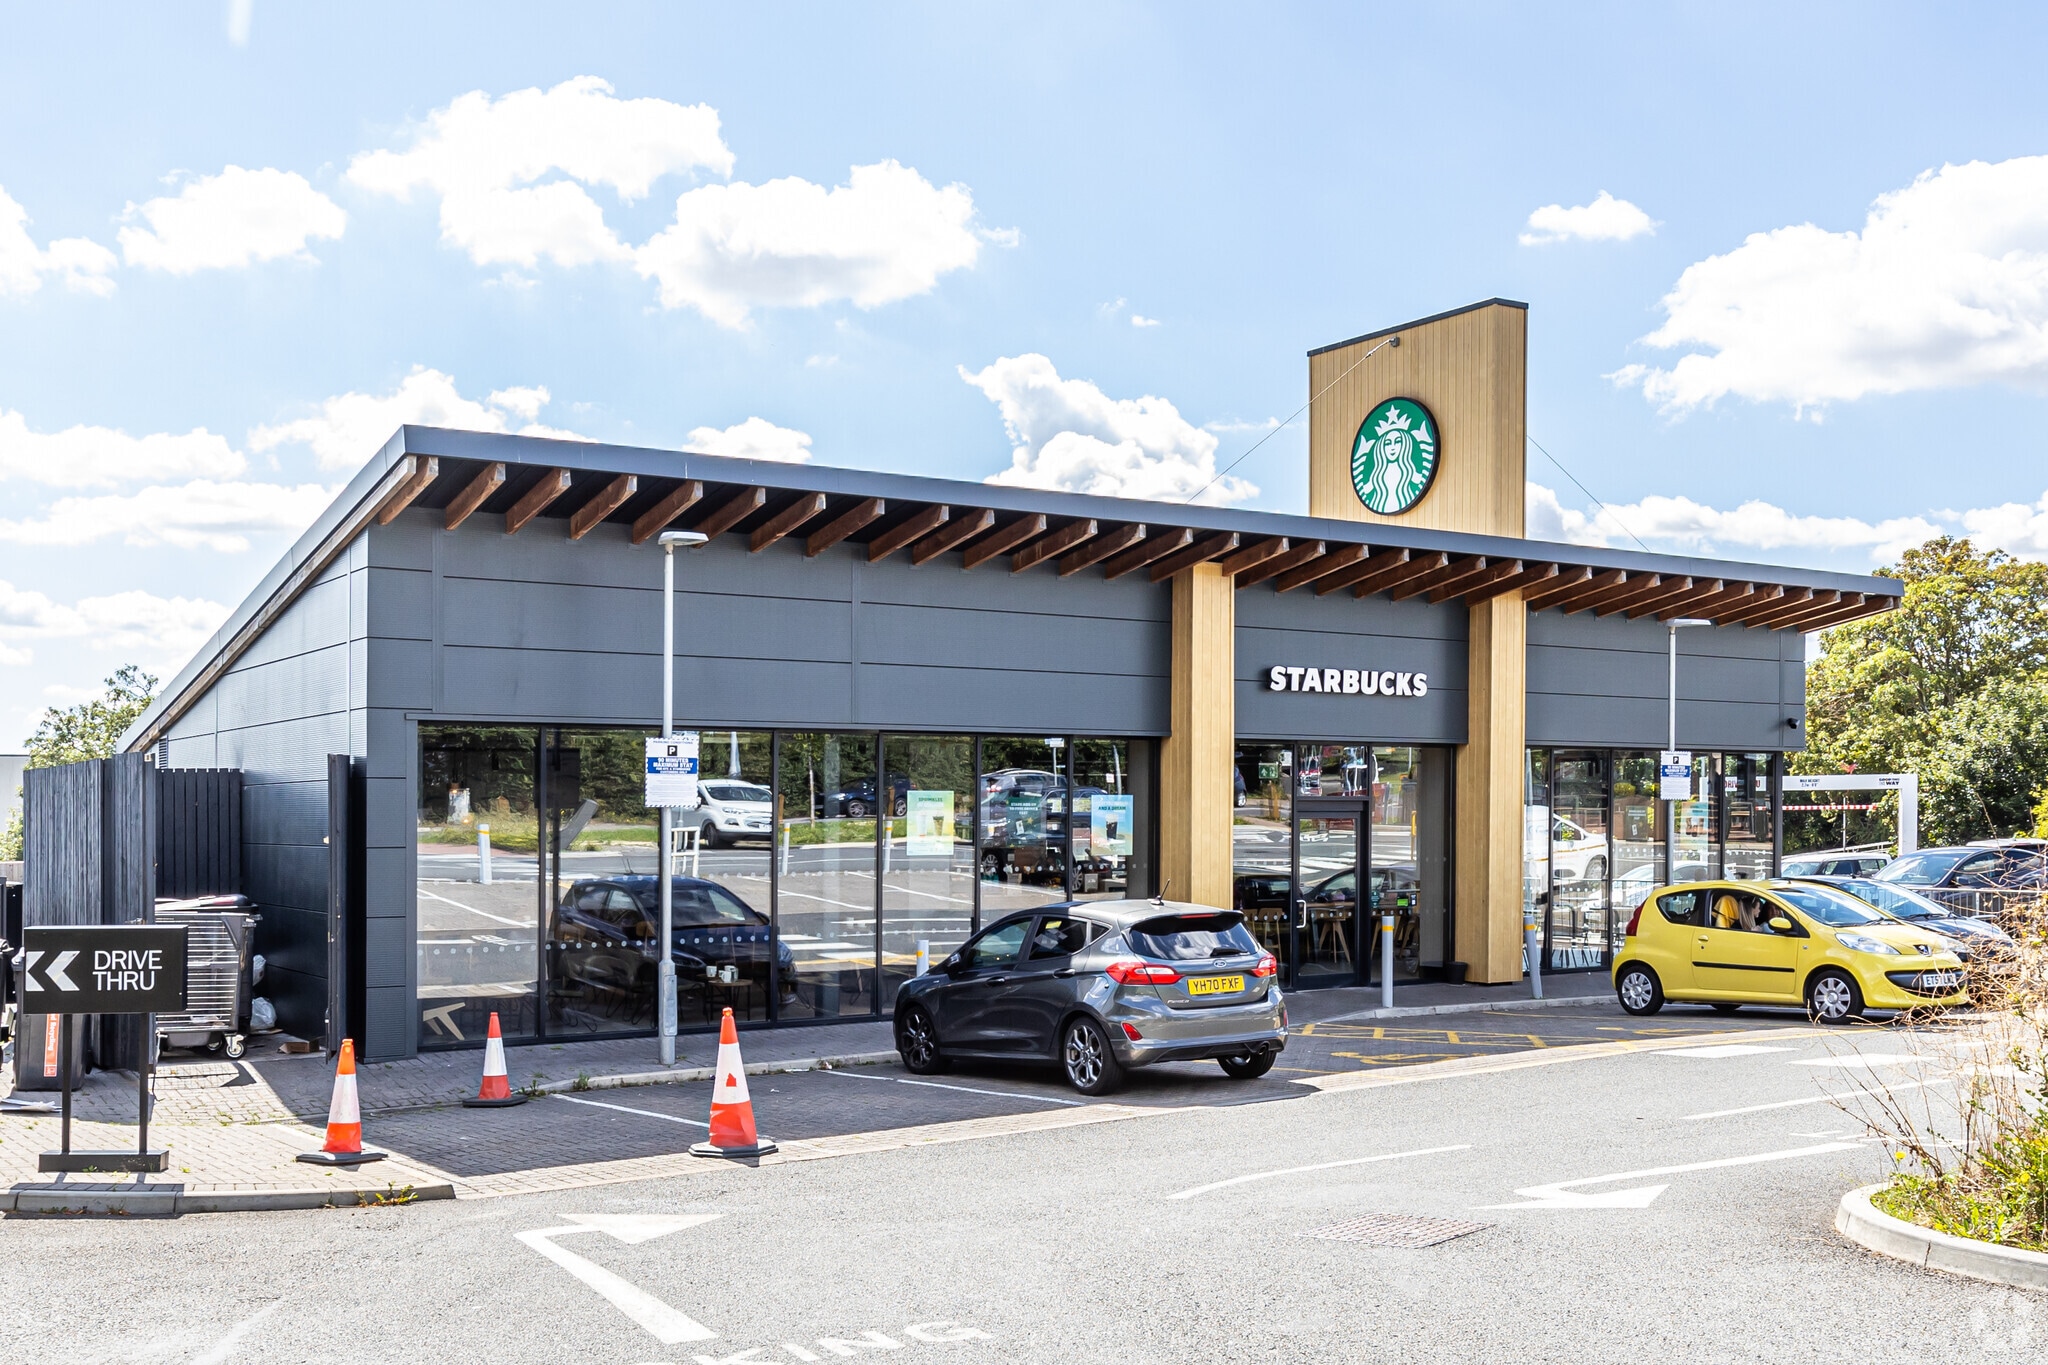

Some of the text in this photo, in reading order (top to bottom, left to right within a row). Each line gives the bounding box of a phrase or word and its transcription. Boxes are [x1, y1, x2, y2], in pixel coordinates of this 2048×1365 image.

[1270, 666, 1428, 697] STARBUCKS
[94, 950, 163, 970] DRIVE
[92, 970, 155, 991] THRU
[1193, 977, 1240, 991] YH70 FXF
